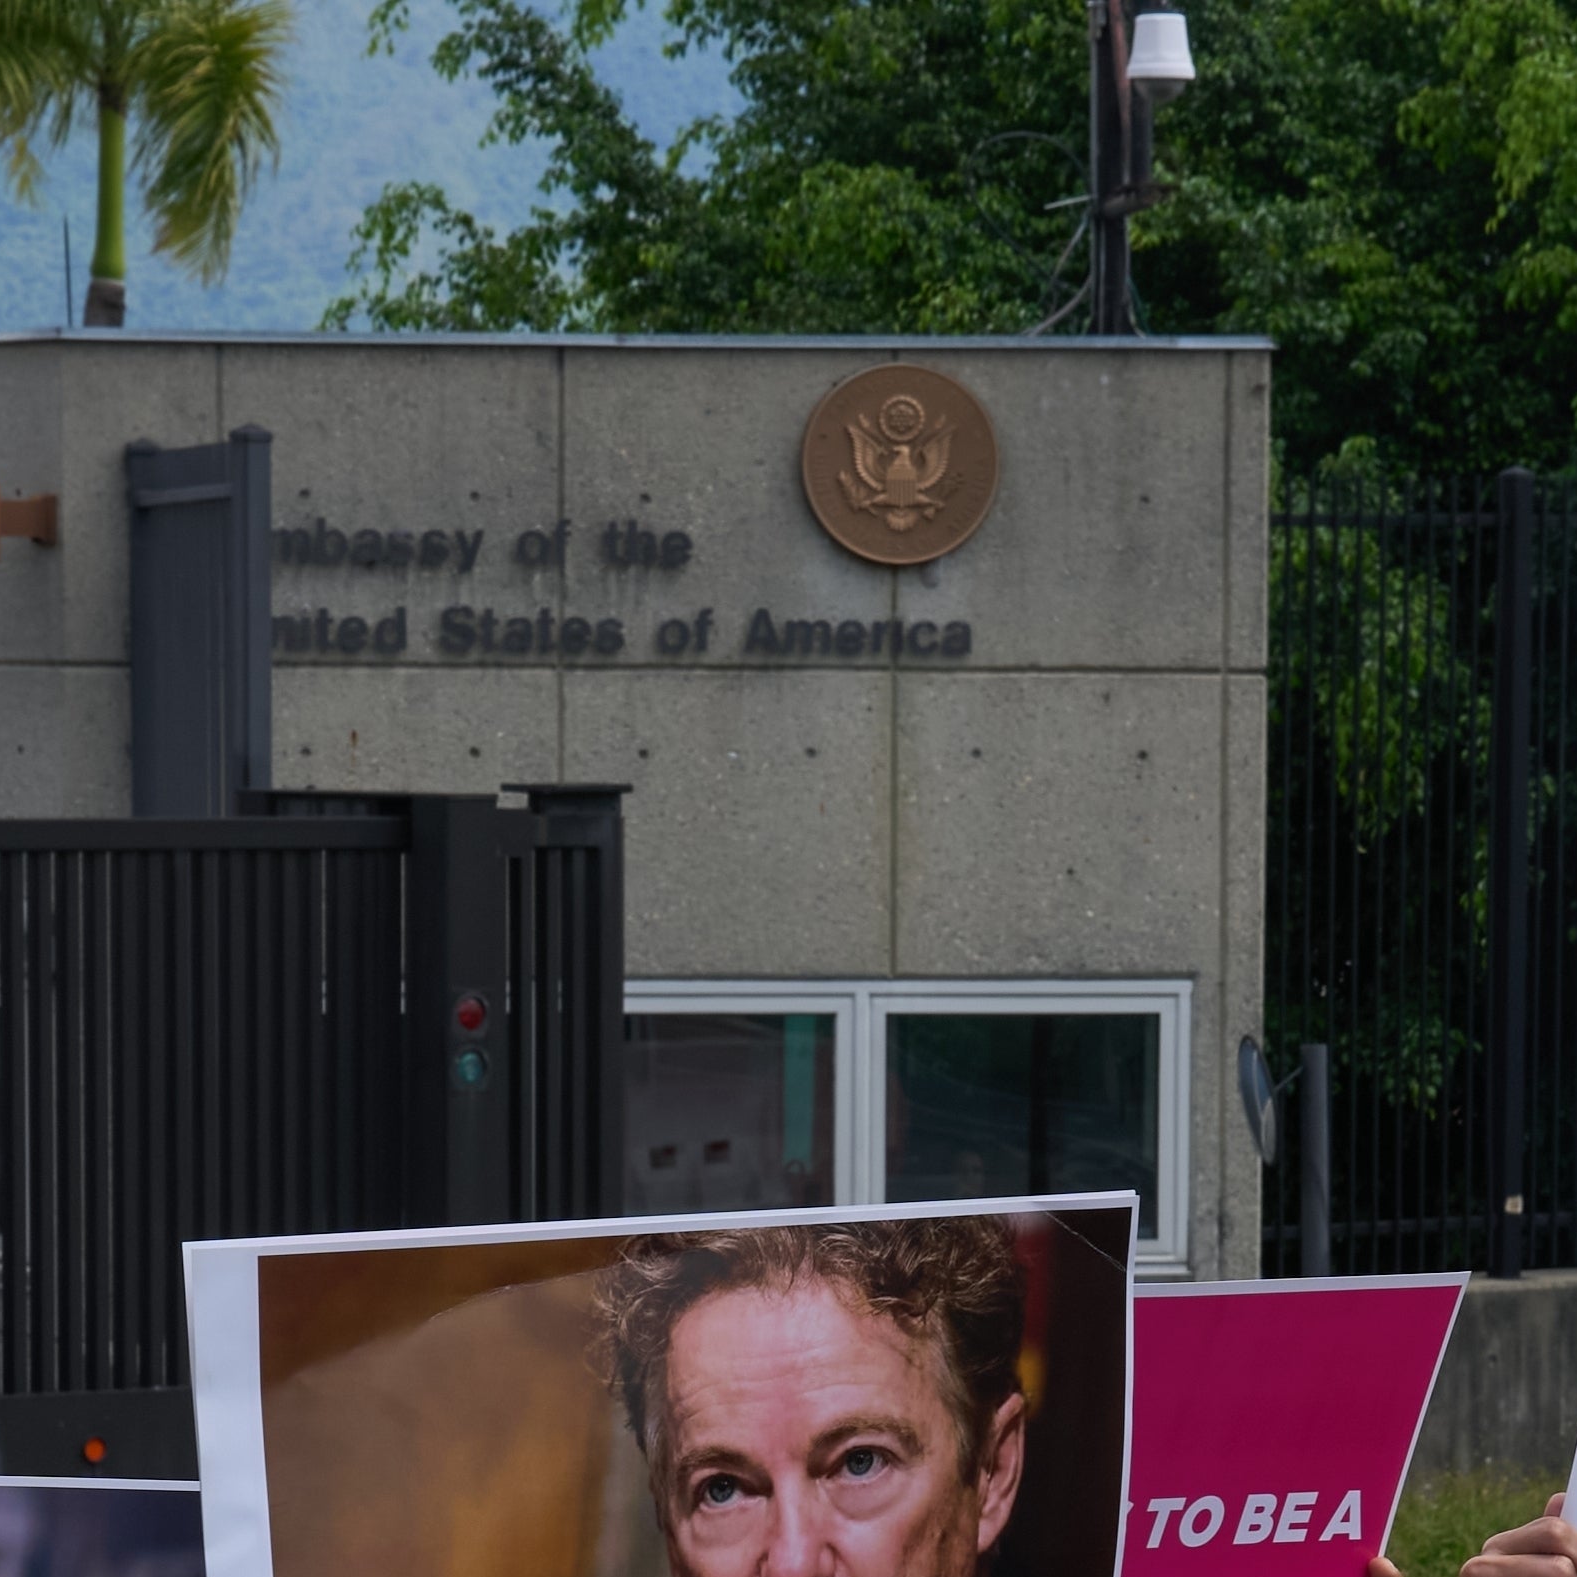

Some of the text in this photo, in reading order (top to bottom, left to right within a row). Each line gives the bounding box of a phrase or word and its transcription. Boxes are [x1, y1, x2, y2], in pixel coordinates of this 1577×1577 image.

[271, 517, 694, 573] mbassy of the
[271, 606, 972, 656] nited States of America
[1146, 1489, 1362, 1549] TO BE A
